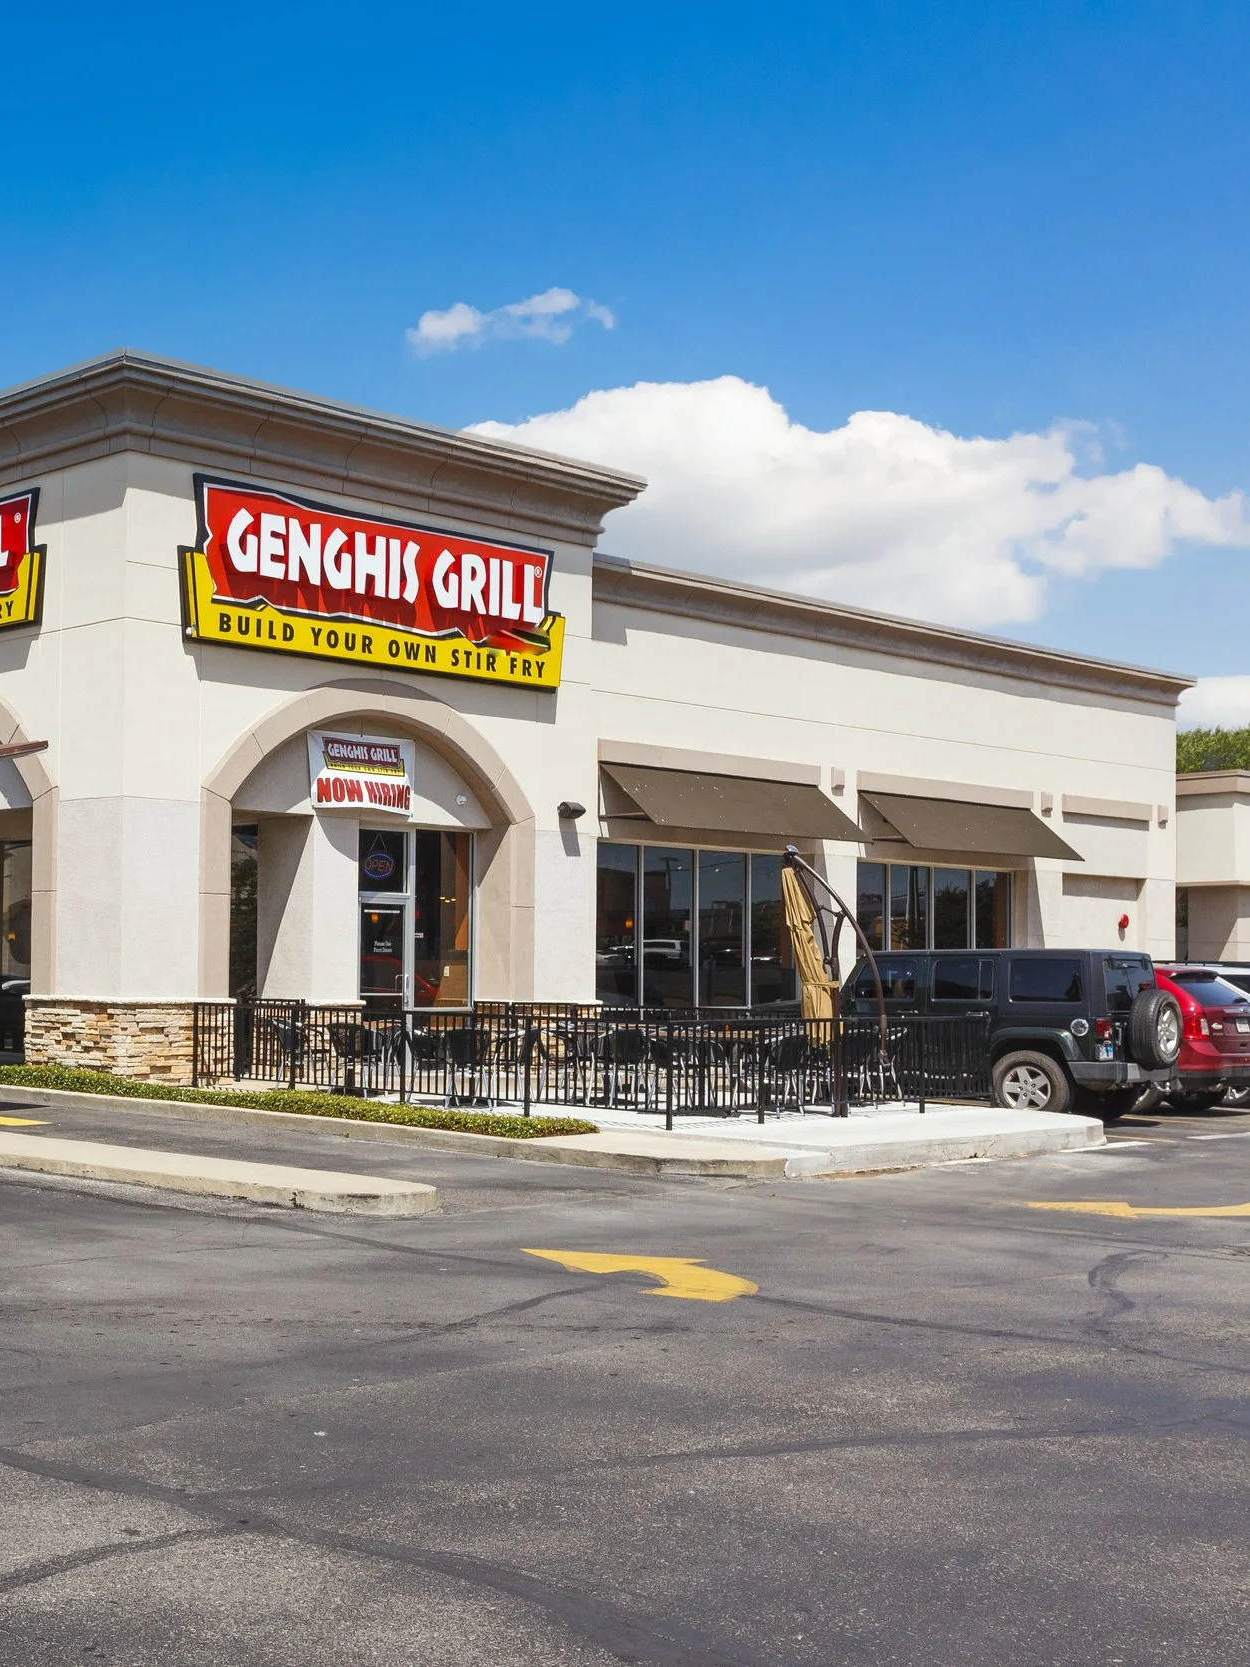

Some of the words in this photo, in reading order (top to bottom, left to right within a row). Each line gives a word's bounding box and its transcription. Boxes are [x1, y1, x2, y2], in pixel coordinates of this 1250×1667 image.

[226, 507, 420, 604] GENGHIS
[431, 549, 543, 624] GRILL
[218, 612, 296, 642] BUILD
[310, 627, 374, 655] YOUR
[388, 640, 437, 664] OWN
[451, 649, 497, 672] STIR
[509, 656, 546, 679] FRY
[327, 743, 369, 760] GENGHIS
[371, 748, 398, 762] GRILL
[317, 777, 363, 803] NOW
[364, 780, 411, 811] HIRING
[365, 859, 394, 873] OPEN
